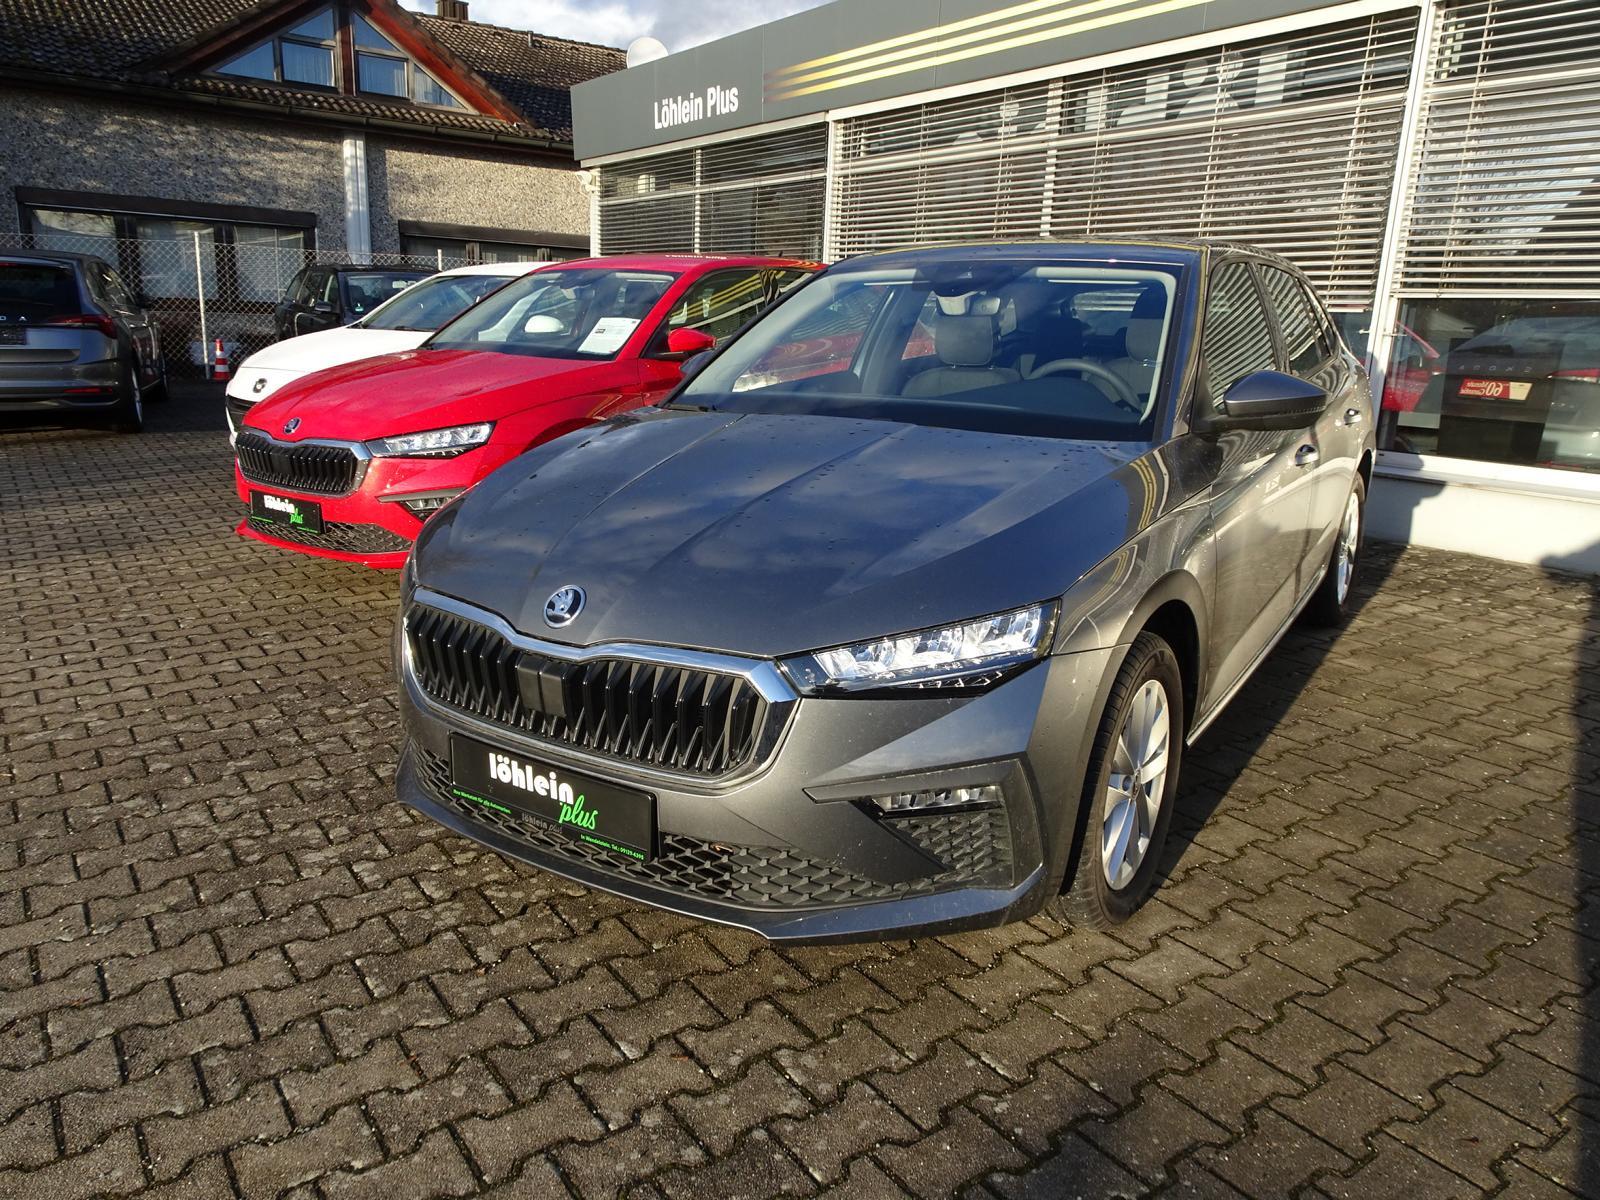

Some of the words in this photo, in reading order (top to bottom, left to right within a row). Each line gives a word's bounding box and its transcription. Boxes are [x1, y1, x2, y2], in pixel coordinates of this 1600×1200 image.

[654, 92, 703, 129] Löhlein
[707, 85, 739, 117] Plus
[489, 752, 574, 805] löhlein
[559, 793, 598, 830] plus
